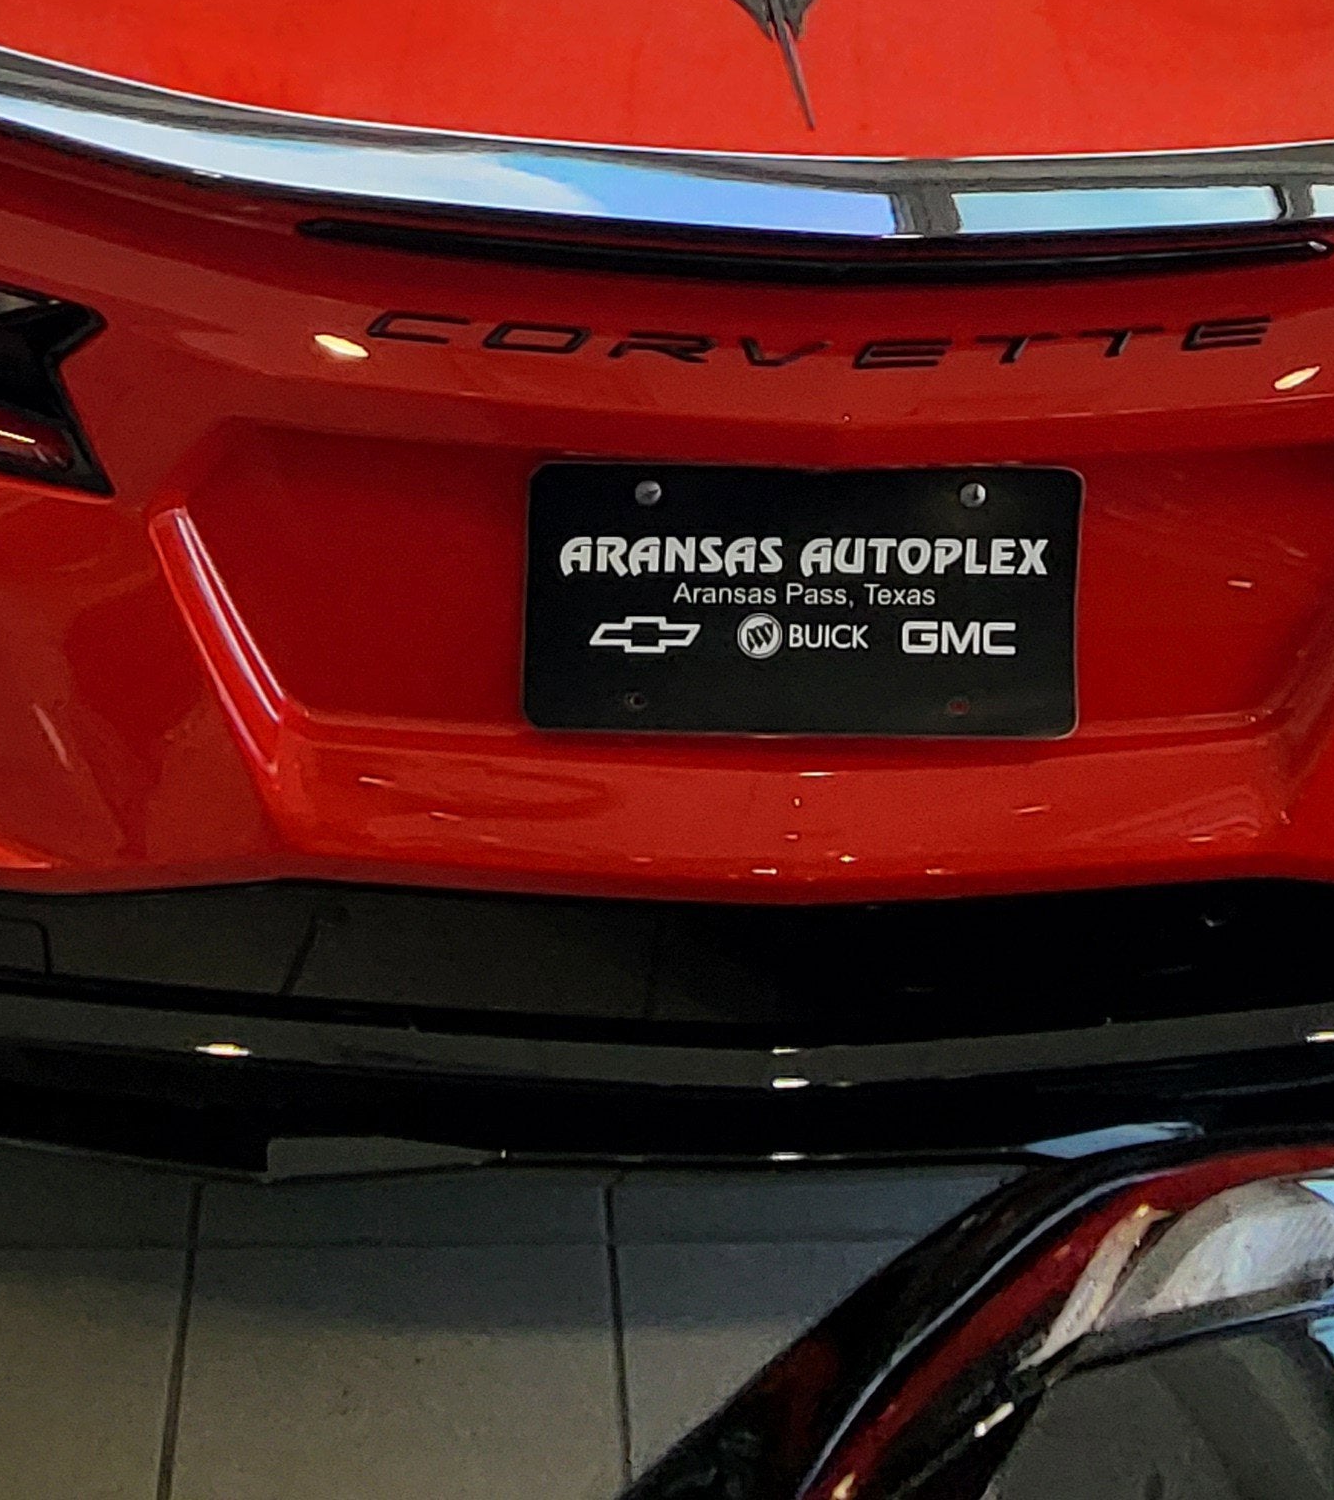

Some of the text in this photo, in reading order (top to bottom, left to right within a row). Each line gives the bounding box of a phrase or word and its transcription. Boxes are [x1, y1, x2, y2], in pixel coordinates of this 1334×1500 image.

[365, 308, 1272, 369] CORVETTE
[559, 536, 1049, 578] ARANSAS AUTOPLEX
[673, 583, 937, 609] Aransas Pass, Texas
[788, 621, 1017, 656] BUICK GMC
